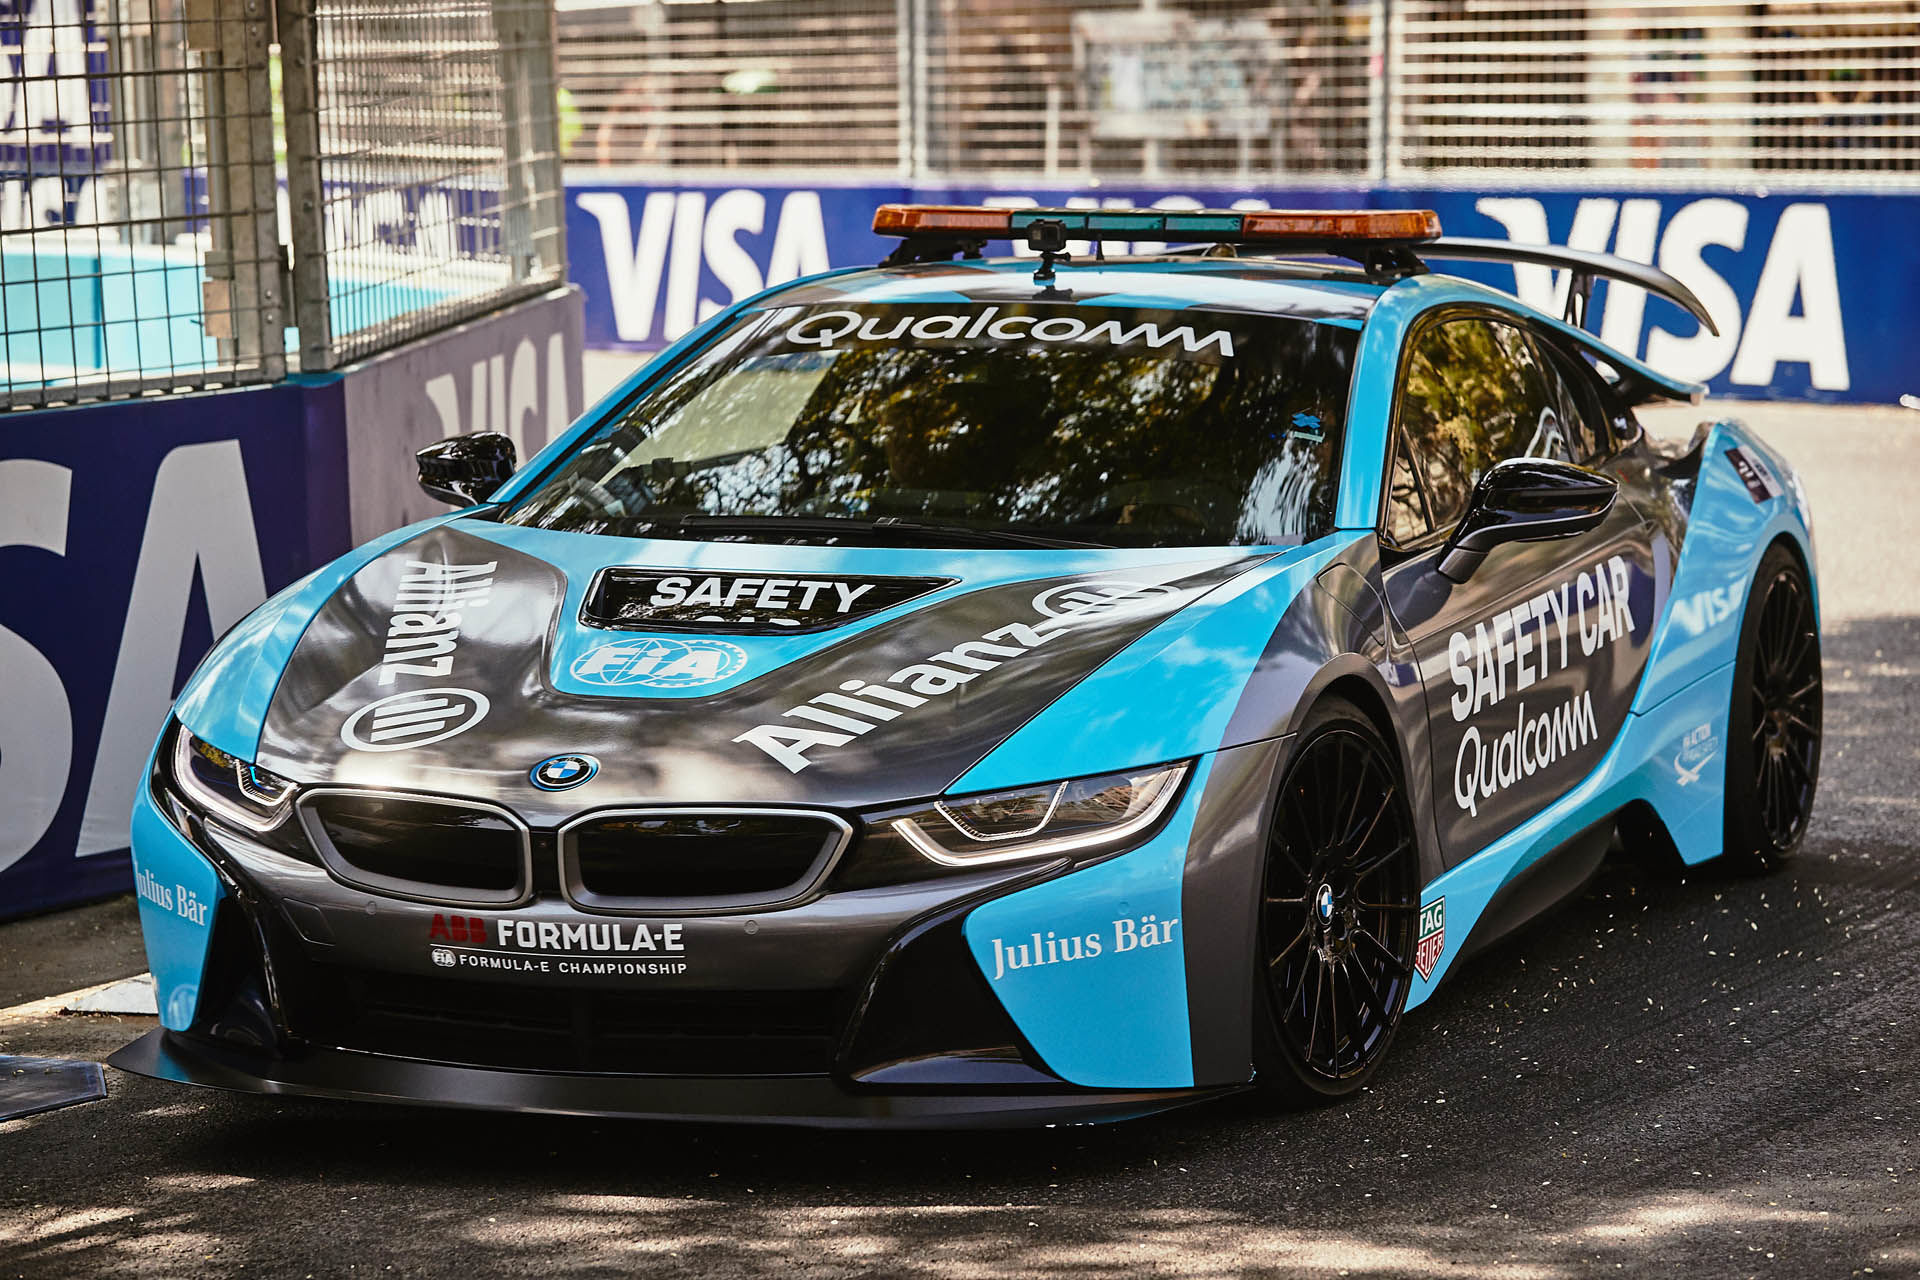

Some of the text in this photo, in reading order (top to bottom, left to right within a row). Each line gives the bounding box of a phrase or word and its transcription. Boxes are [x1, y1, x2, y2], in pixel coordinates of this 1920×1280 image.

[576, 189, 834, 342] VISA
[1476, 197, 1850, 391] VISA
[787, 307, 1235, 357] Qualcomm
[378, 560, 498, 686] Allianz
[650, 577, 876, 613] SAFETY
[1449, 555, 1635, 722] SAFETY CAR
[731, 621, 1072, 775] Allianz
[1454, 690, 1598, 818] Qualcomm
[175, 884, 208, 927] Bär
[430, 914, 685, 951] ABB FORMULA-E
[1420, 904, 1442, 937] TAG
[460, 955, 550, 972] FORMULA-E
[559, 962, 687, 975] CHAMPIONSHIP
[992, 914, 1179, 980] Julius Bär
